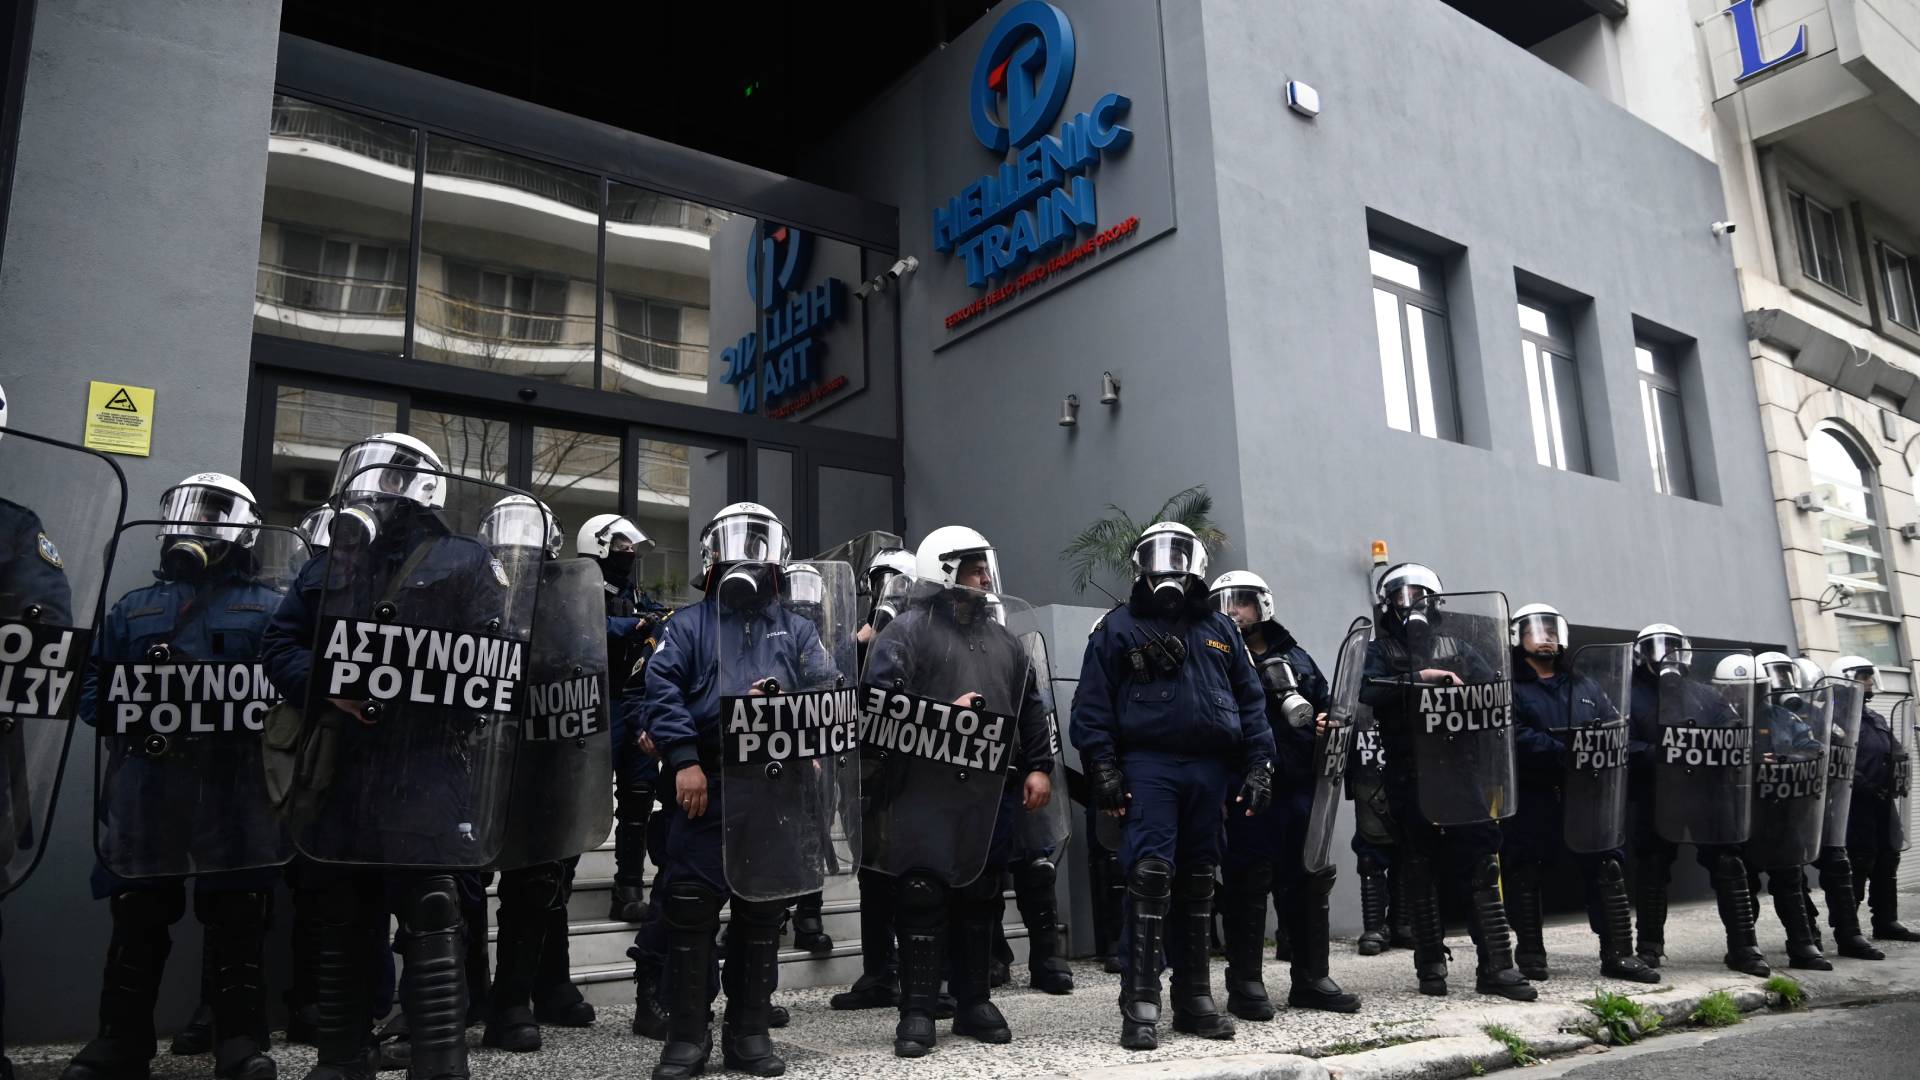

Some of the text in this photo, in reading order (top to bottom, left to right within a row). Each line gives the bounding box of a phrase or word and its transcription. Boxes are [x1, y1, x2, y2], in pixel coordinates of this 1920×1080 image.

[933, 93, 1133, 251] HELLENIC
[957, 176, 1096, 288] TRAIN
[944, 299, 985, 329] FERROVIE
[1017, 266, 1046, 290] STATO
[1047, 238, 1096, 273] ITALIANE
[1096, 215, 1138, 247] GROUP
[324, 619, 522, 681] ΑΣΤΥΝΟΜΙΑ
[107, 664, 284, 702] ΑΣΤΥΝΟΜ
[329, 661, 514, 712] POLICE
[529, 675, 600, 717] ΝΟΜΙΑ
[1419, 680, 1513, 712] ΑΣΤΥΝΟΜΙΑ
[117, 701, 282, 734] POLIC
[525, 708, 598, 741] LICE
[729, 689, 858, 733] ΑΣΤΥΝΟΜΙΑ
[866, 688, 1005, 741] POLICE
[1425, 705, 1512, 733] POLICE
[738, 722, 857, 762] POLICE
[858, 710, 1006, 771] ΑΣΤΥΝΟΜΙΑ
[1576, 746, 1629, 769] POLIC
[1662, 726, 1753, 750] ΑΣΤΥΝΟΜΙΑ
[1666, 747, 1751, 766] POLICE
[1760, 778, 1825, 799] POLIC
